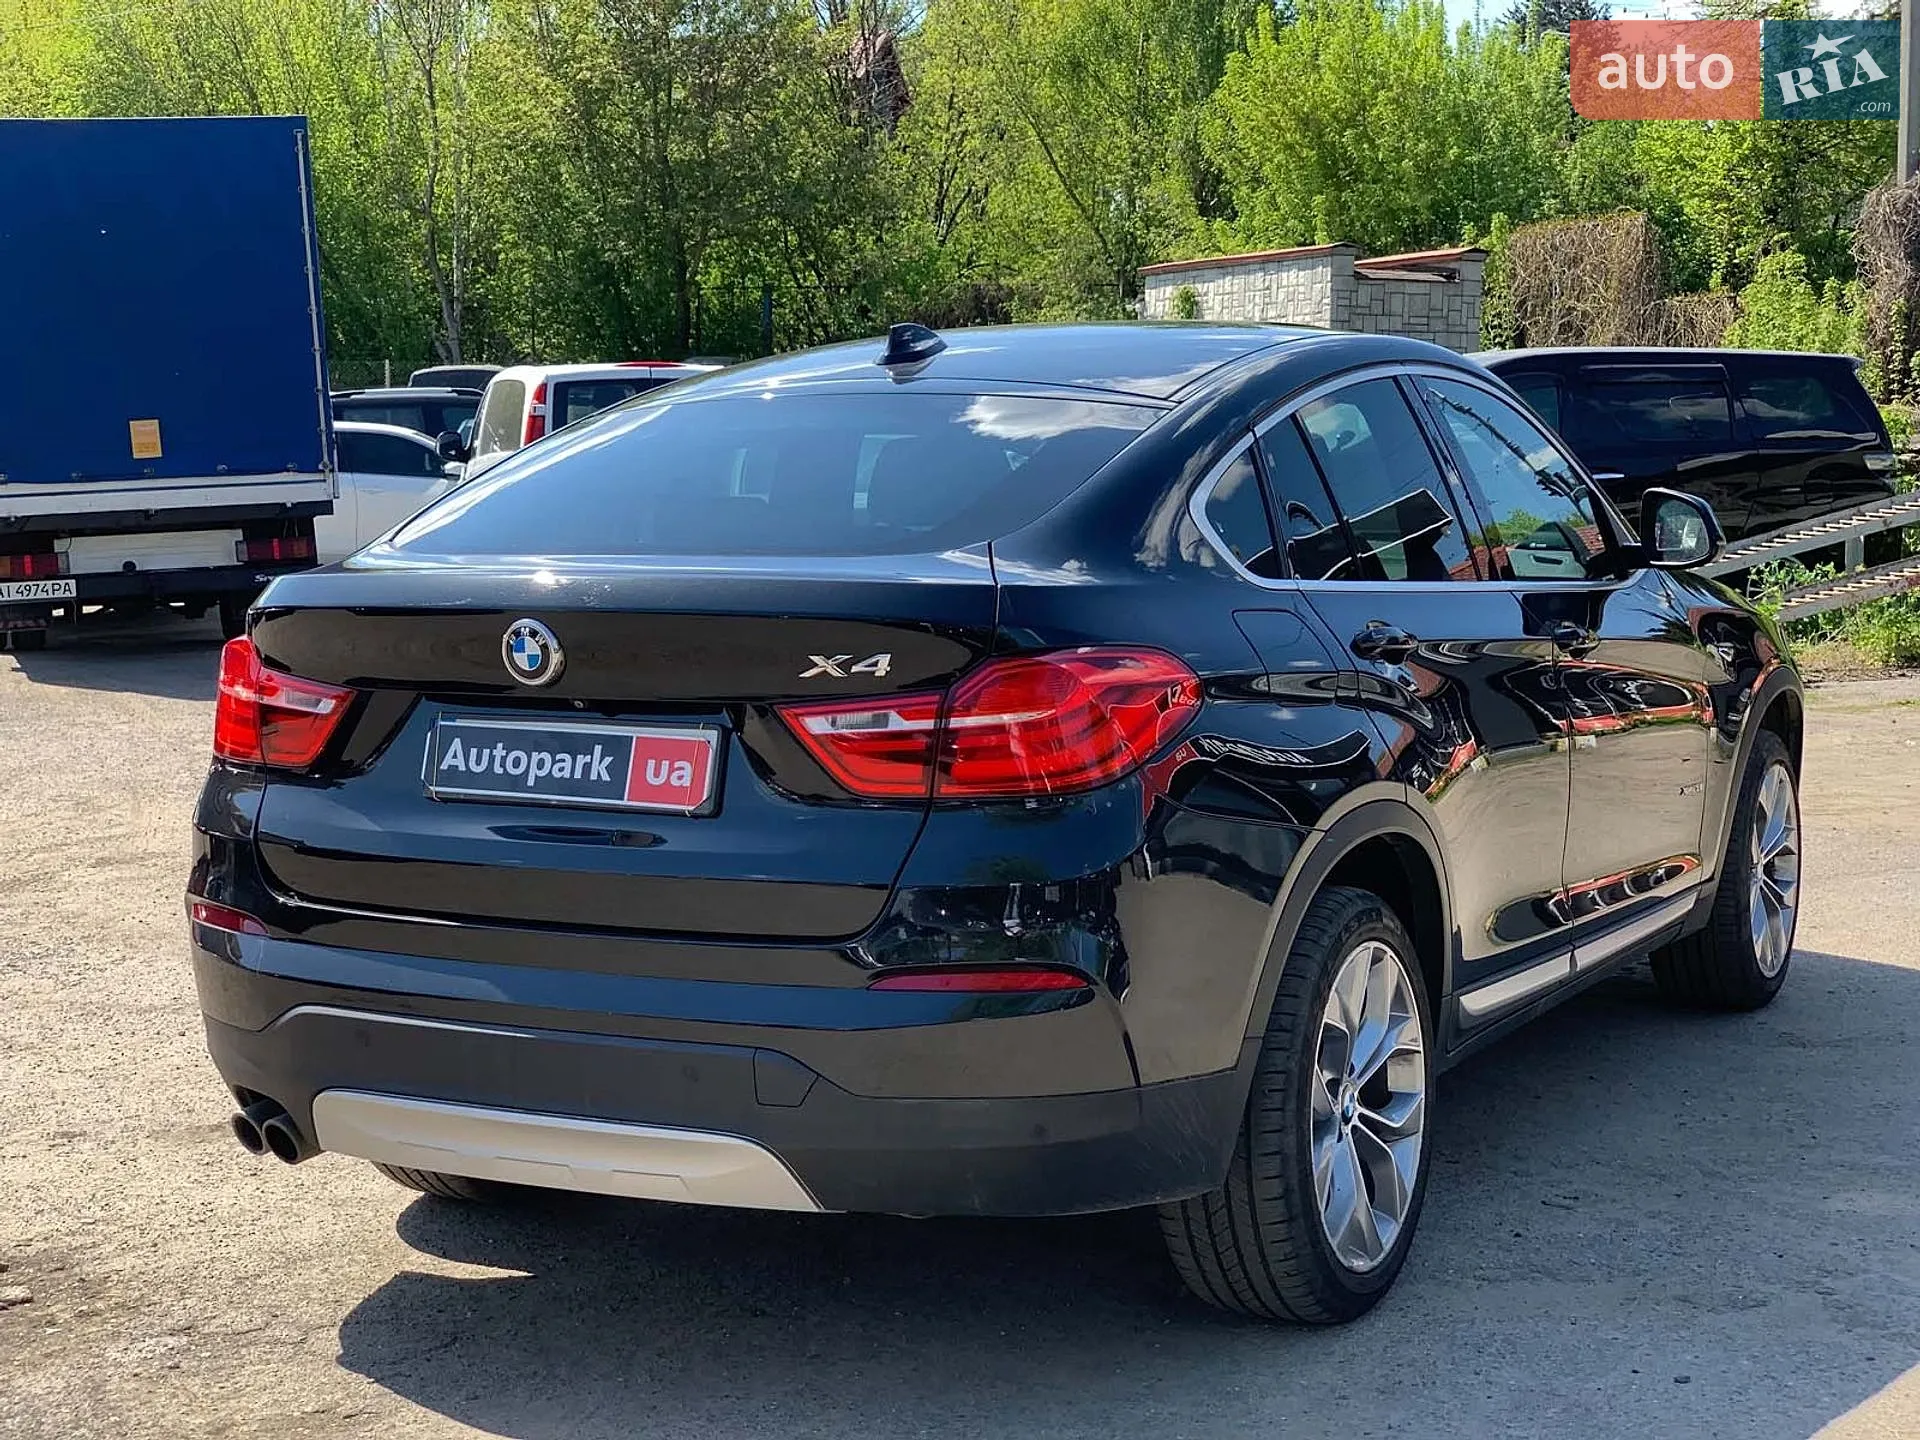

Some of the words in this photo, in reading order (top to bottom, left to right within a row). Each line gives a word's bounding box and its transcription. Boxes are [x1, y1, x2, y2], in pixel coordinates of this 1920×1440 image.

[508, 626, 546, 646] BMW
[799, 653, 892, 677] X4
[440, 737, 614, 787] Autopark
[645, 758, 693, 787] ua
